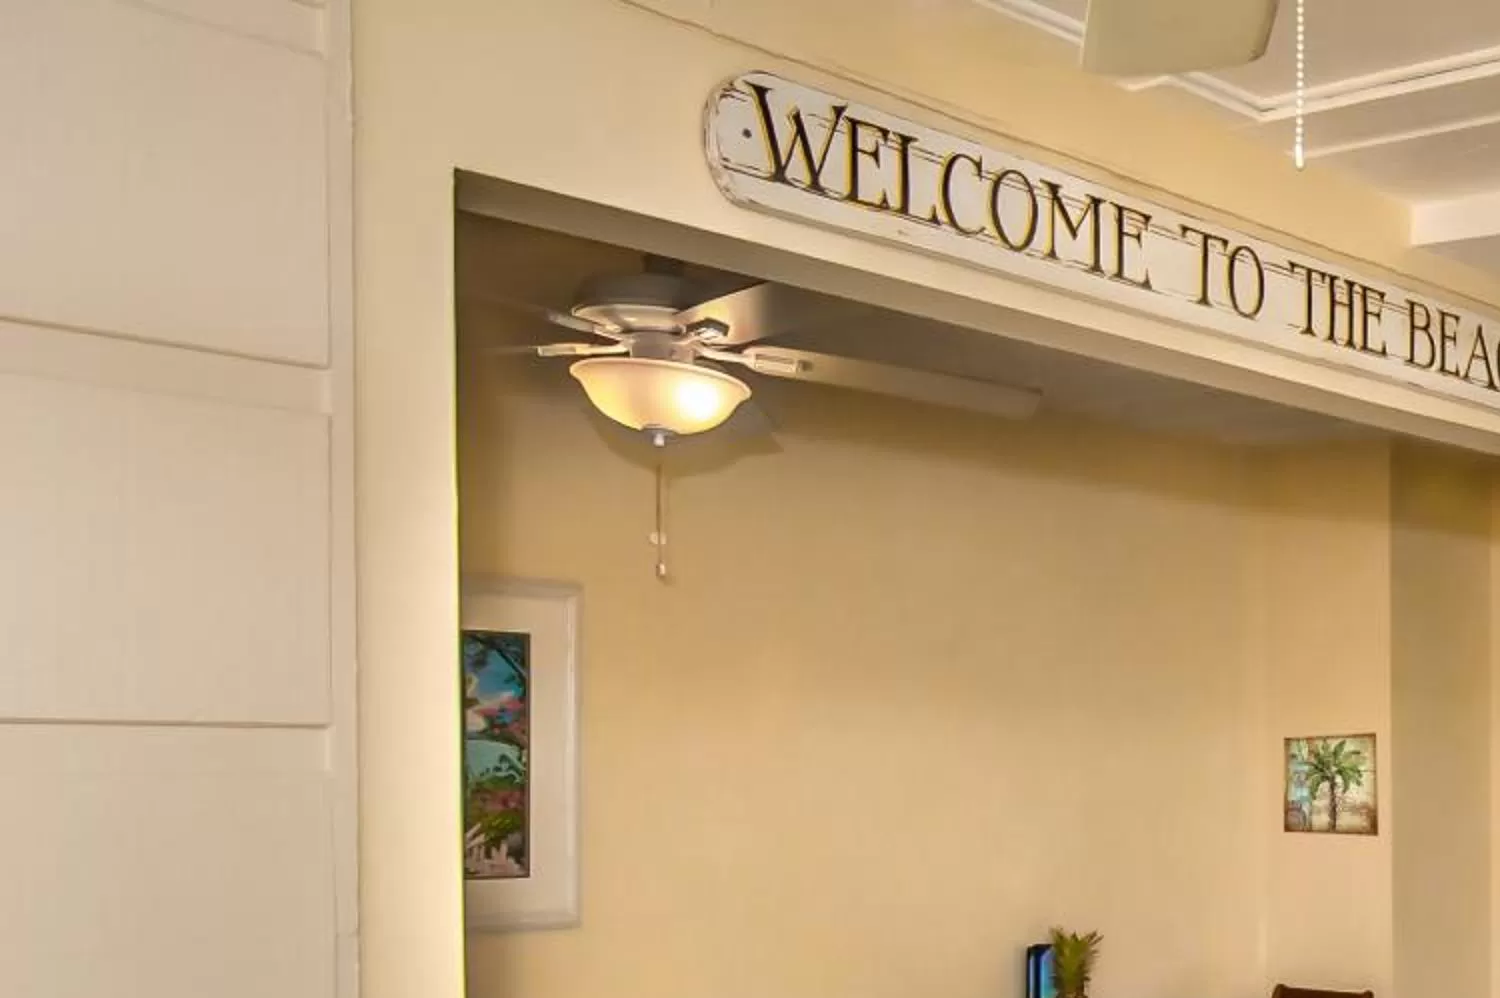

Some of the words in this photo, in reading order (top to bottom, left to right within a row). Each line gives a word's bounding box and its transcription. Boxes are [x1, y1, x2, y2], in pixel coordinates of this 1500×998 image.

[744, 81, 1152, 289] WELCOME
[1181, 223, 1265, 320] TO
[1288, 260, 1387, 358] THE
